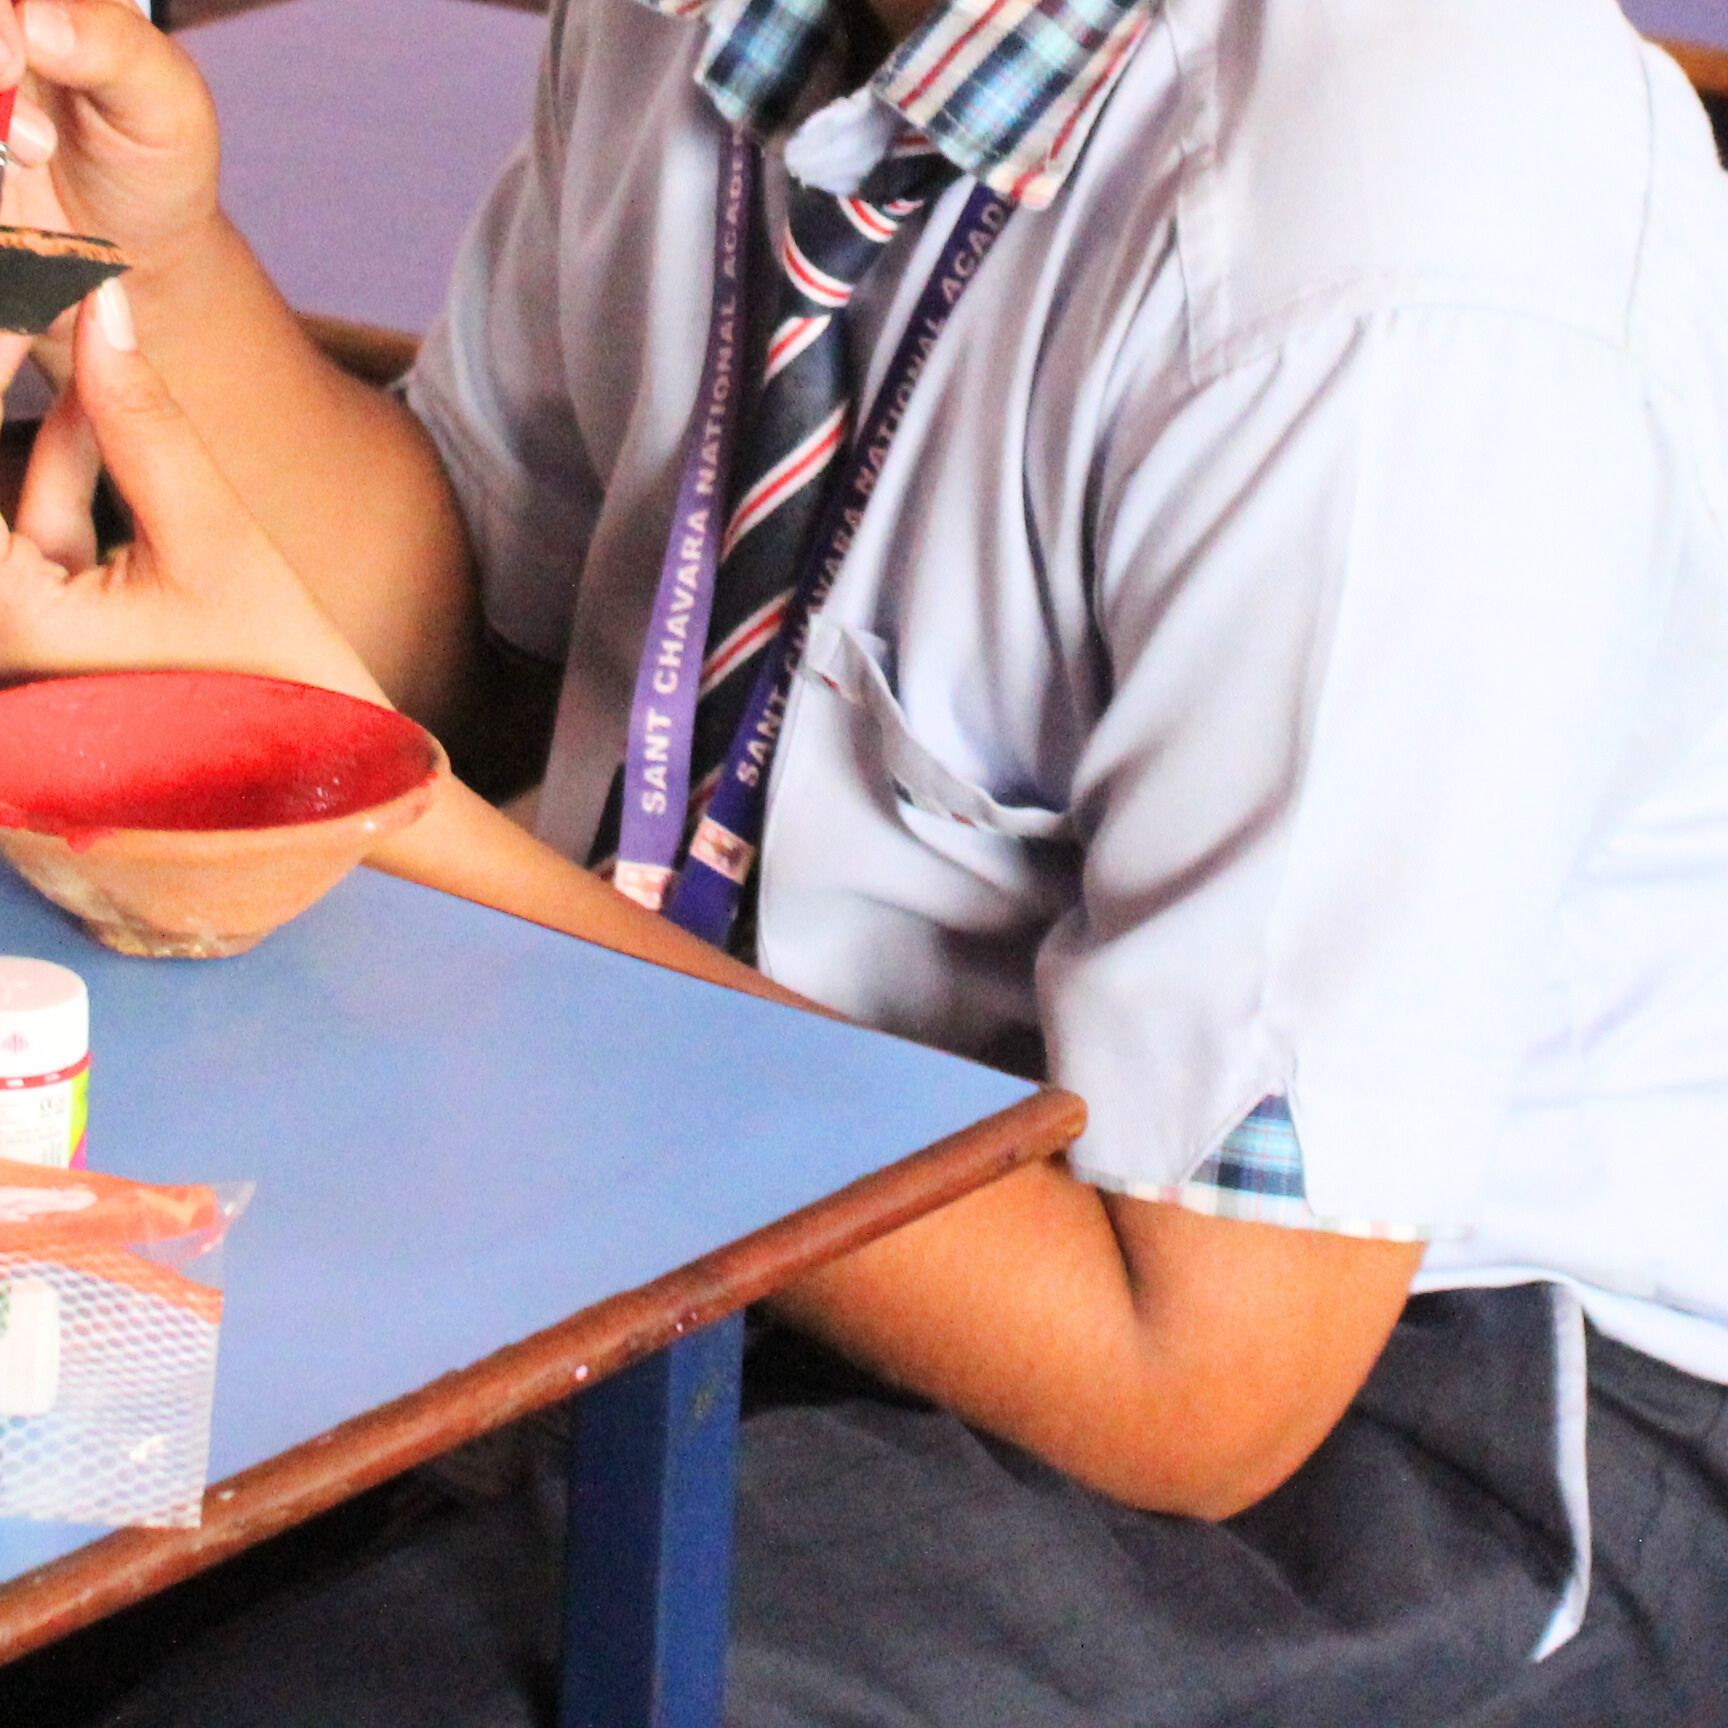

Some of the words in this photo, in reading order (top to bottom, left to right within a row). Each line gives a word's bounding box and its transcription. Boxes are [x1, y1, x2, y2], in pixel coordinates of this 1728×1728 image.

[696, 293, 736, 496] NATIONAL
[653, 508, 710, 695] CHAVARA
[641, 706, 673, 816] SANT
[735, 683, 788, 788] SANT
